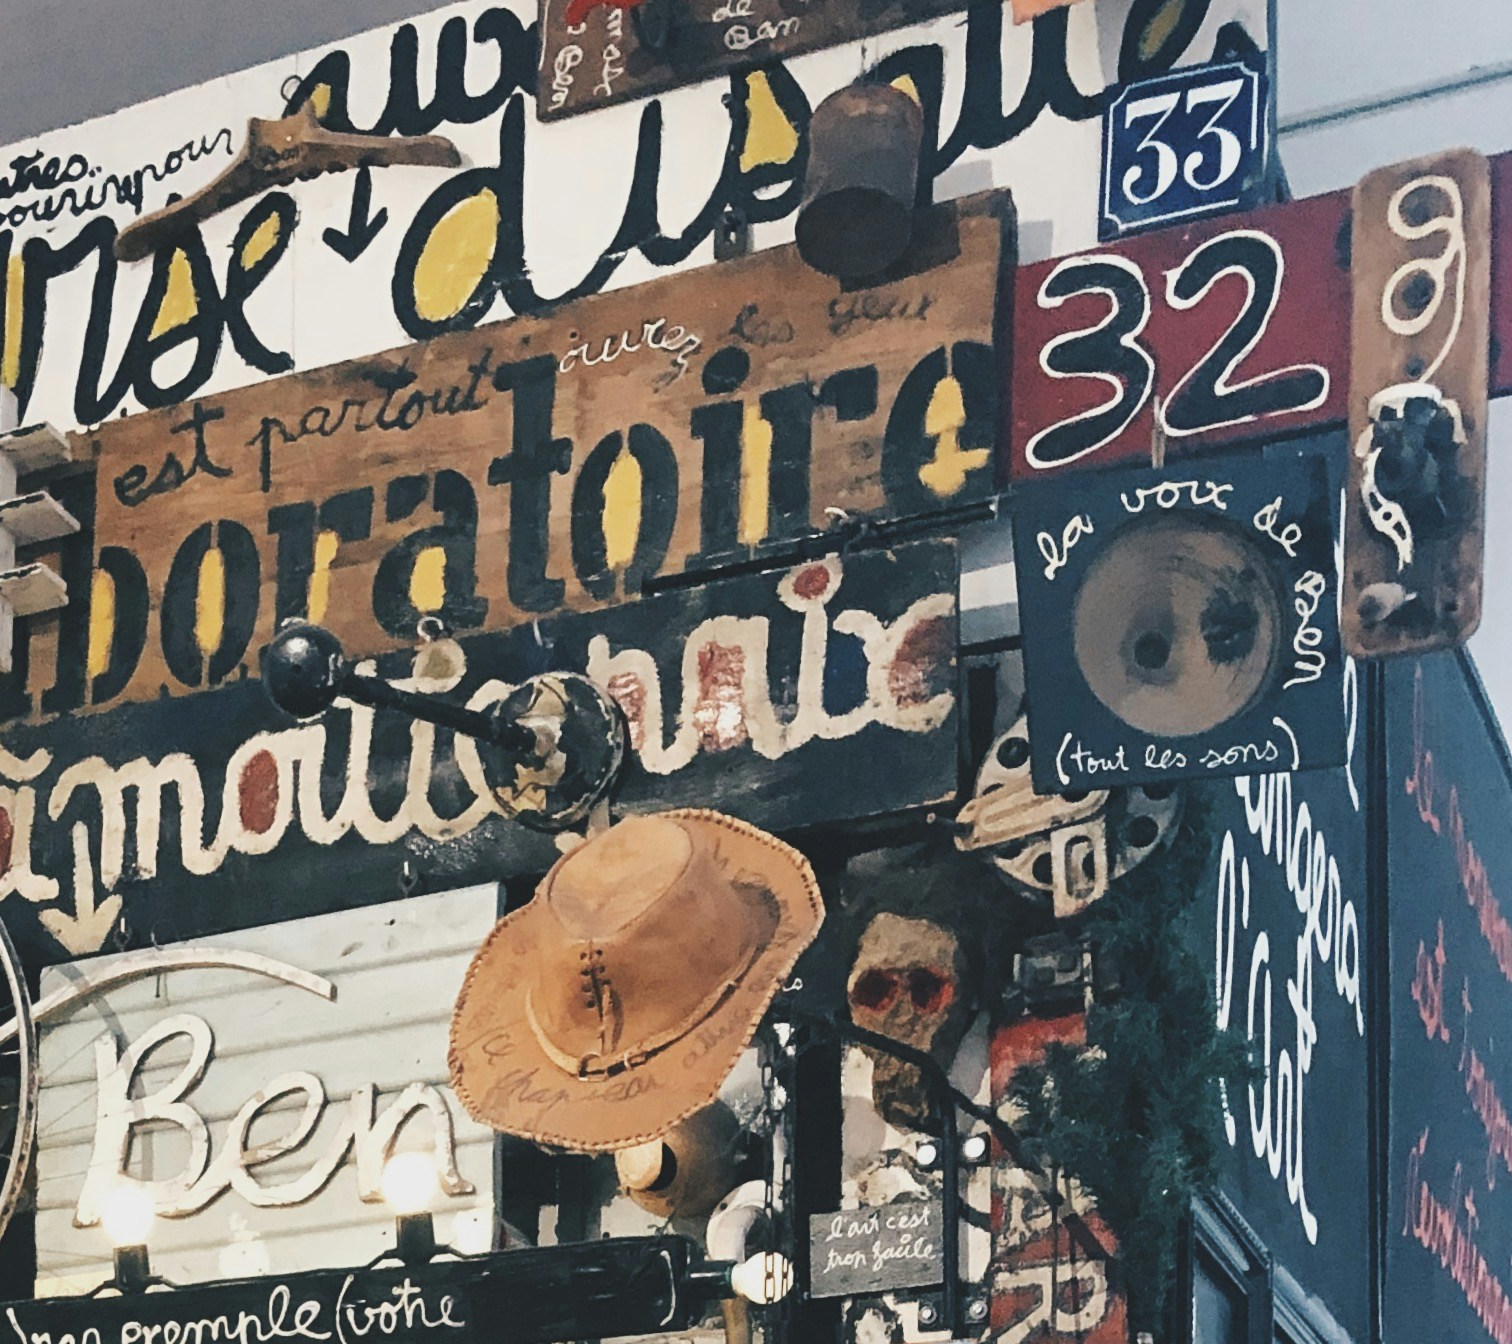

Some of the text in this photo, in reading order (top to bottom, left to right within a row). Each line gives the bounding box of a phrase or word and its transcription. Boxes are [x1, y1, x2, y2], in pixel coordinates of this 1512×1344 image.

[1122, 80, 1244, 204] 33
[1024, 230, 1331, 470] 32
[114, 346, 493, 504] est partout
[1121, 480, 1234, 513] voix
[1144, 742, 1188, 770] les
[71, 1014, 478, 1232] Ben
